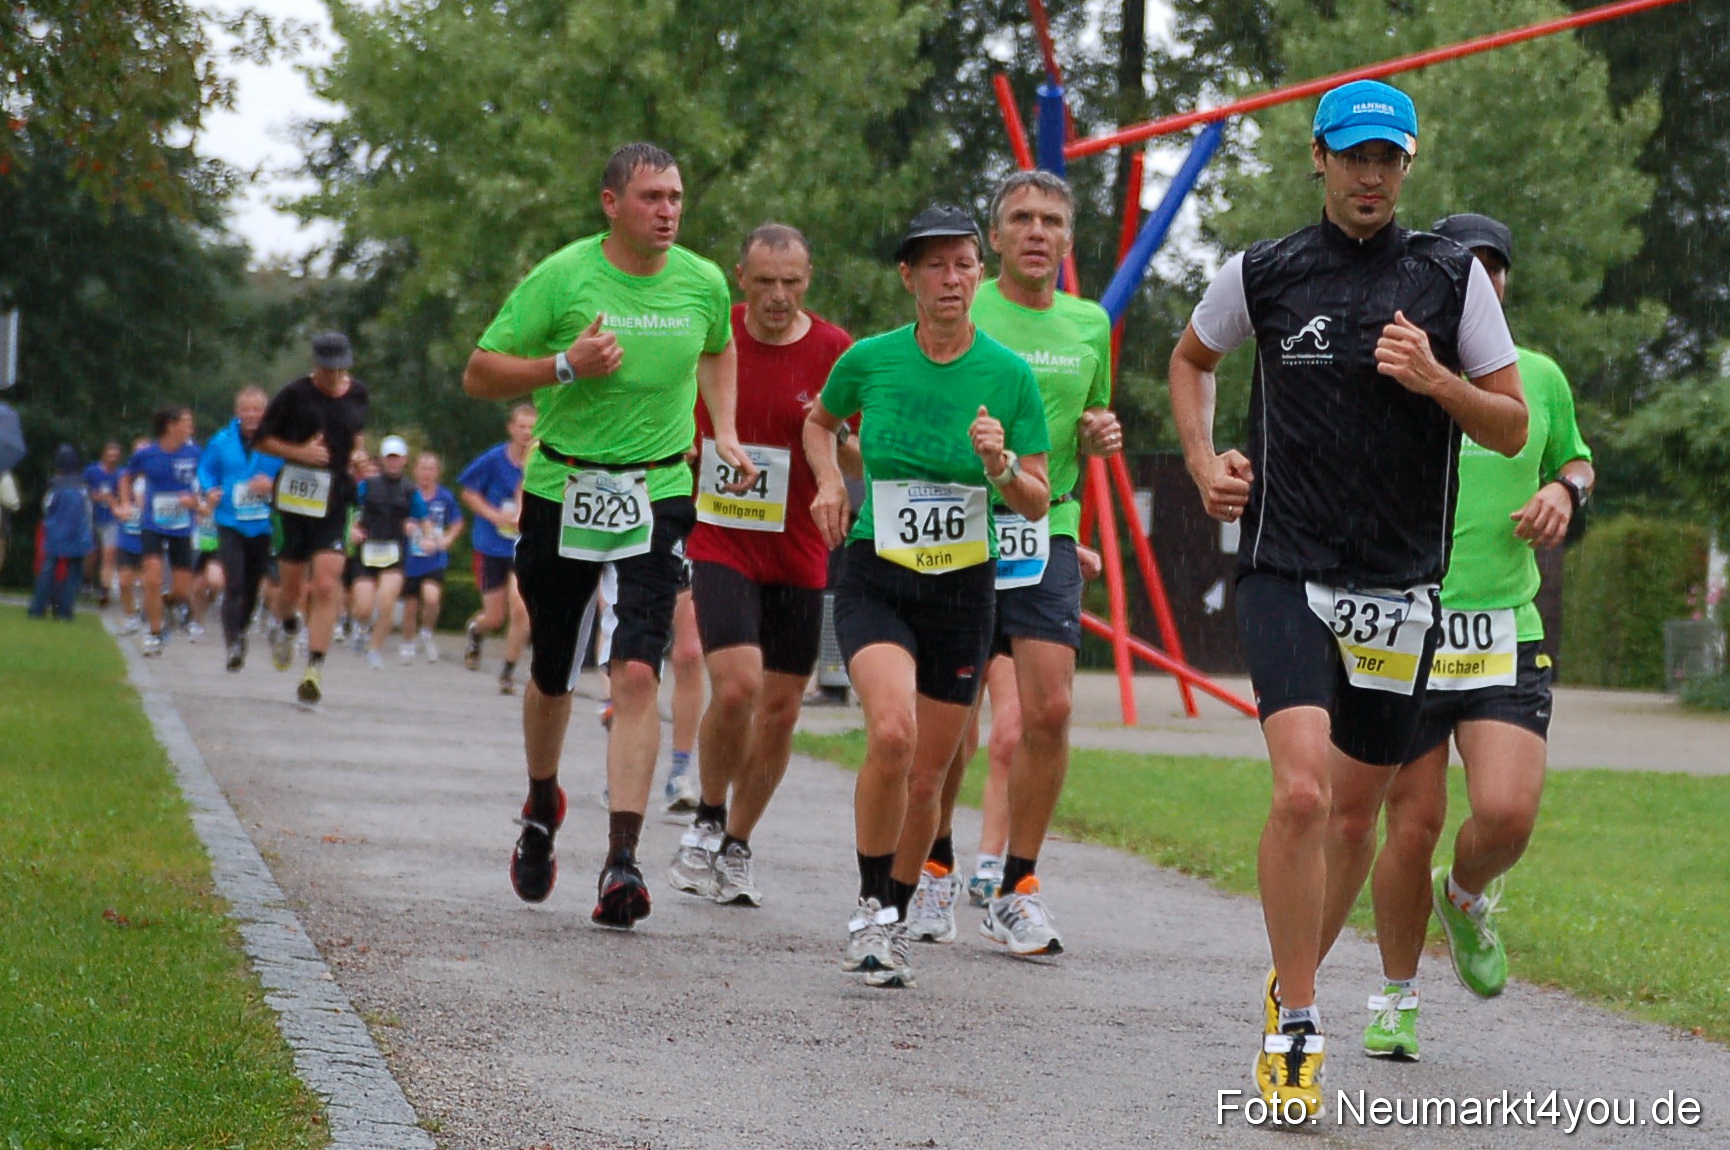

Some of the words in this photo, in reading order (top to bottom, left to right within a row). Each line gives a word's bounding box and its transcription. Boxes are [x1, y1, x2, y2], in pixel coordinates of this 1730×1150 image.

[289, 479, 319, 498] 697
[573, 491, 641, 528] 5229
[713, 500, 766, 521] Wolfgang
[898, 506, 965, 544] 346
[1000, 527, 1037, 557] 56
[916, 551, 952, 567] Karin
[1329, 599, 1403, 647] 331
[1356, 655, 1385, 671] ner
[1432, 659, 1485, 674] Michael
